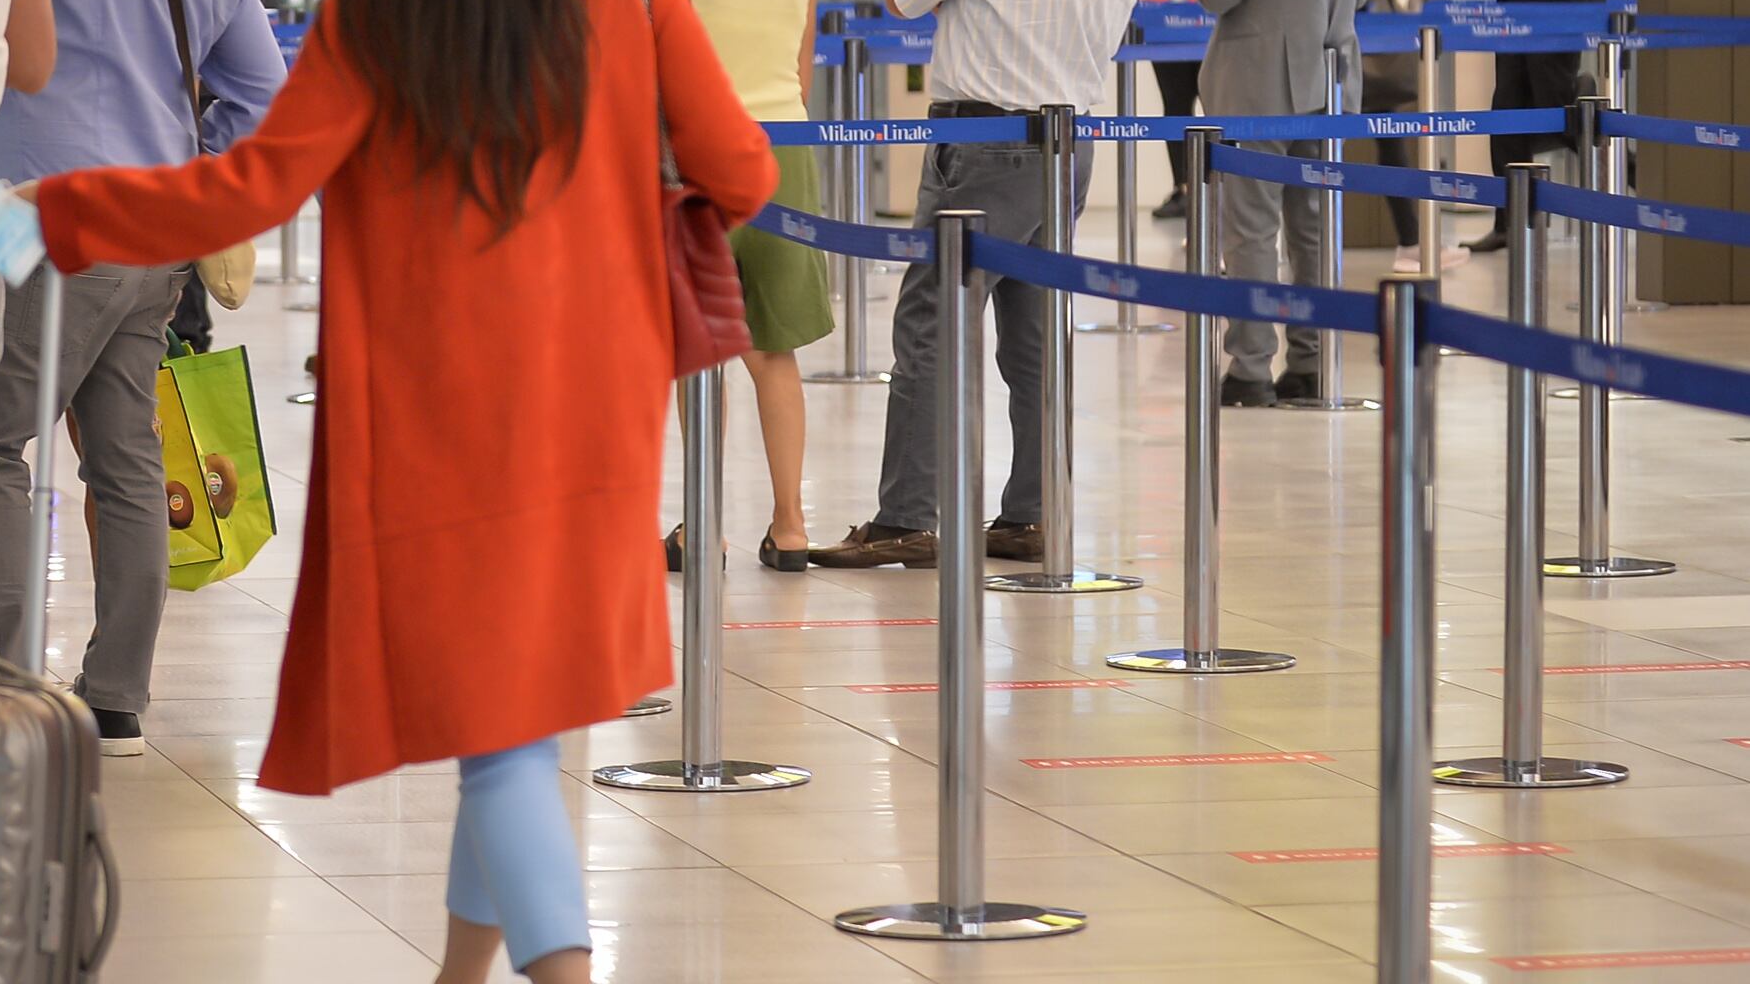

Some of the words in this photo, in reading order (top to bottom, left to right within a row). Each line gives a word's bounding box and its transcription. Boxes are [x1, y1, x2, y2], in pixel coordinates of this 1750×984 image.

[818, 124, 875, 142] Milano
[883, 124, 933, 141] Linate
[1100, 120, 1149, 137] Linate
[1367, 117, 1421, 134] Milano
[1429, 117, 1476, 133] Linate
